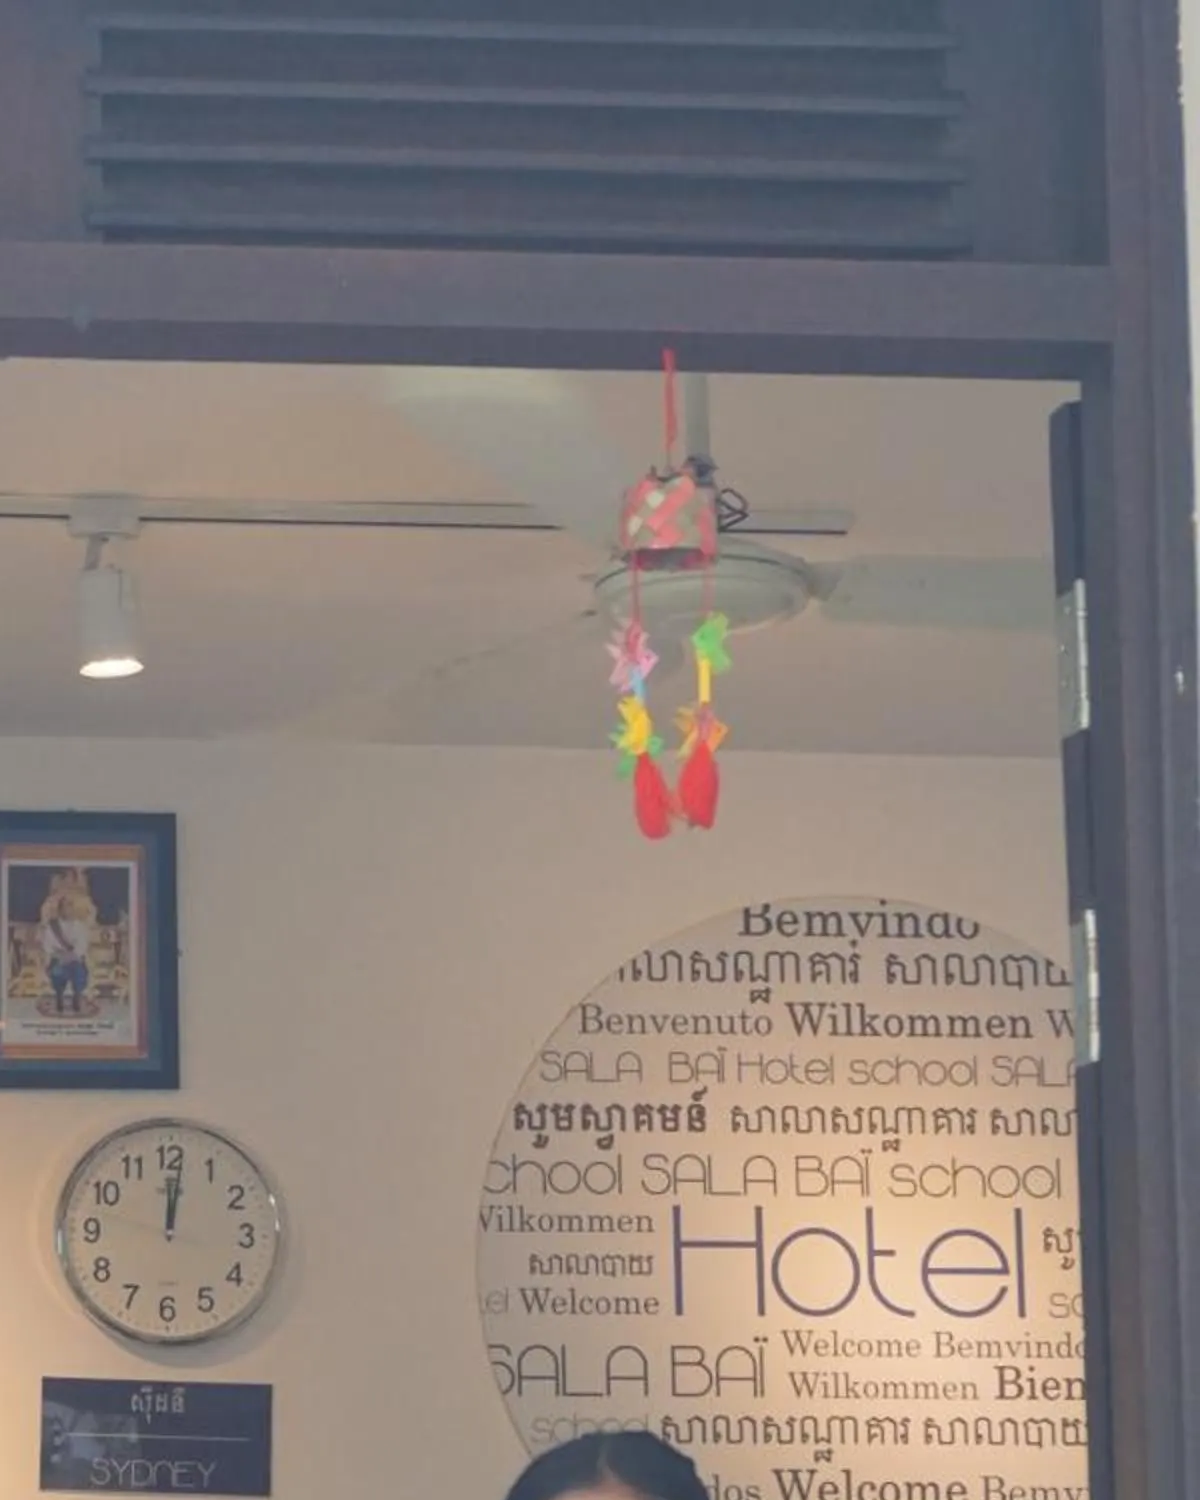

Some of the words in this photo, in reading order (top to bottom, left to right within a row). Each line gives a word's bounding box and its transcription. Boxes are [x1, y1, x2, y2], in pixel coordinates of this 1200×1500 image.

[578, 1002, 773, 1036] Benvenuto
[785, 1001, 1034, 1039] Wilkommen
[540, 1050, 643, 1084] SALA
[668, 1046, 728, 1084] BAÏ
[736, 1052, 835, 1086] Hotel
[848, 1054, 978, 1087] school
[121, 1155, 143, 1180] 11
[155, 1145, 184, 1171] 12
[205, 1158, 214, 1184] 1
[641, 1153, 777, 1196] SALA
[794, 1148, 873, 1197] BAÏ
[887, 1156, 1062, 1200] school
[93, 1180, 120, 1206] 10
[227, 1185, 245, 1210] 2
[83, 1217, 101, 1243] 9
[239, 1223, 255, 1249] 3
[93, 1257, 111, 1283] 8
[672, 1204, 1027, 1318] Hotel
[226, 1262, 243, 1287] 4
[123, 1283, 140, 1310] 7
[159, 1296, 176, 1322] 6
[197, 1287, 214, 1312] 5
[519, 1287, 660, 1315] Welcome
[782, 1329, 921, 1358] Welcome
[488, 1344, 649, 1398] SALA
[671, 1336, 769, 1398] BAÏ
[789, 1370, 979, 1400] Wilkommen
[994, 1364, 1086, 1401] Bien
[90, 1457, 217, 1489] SYDNEY
